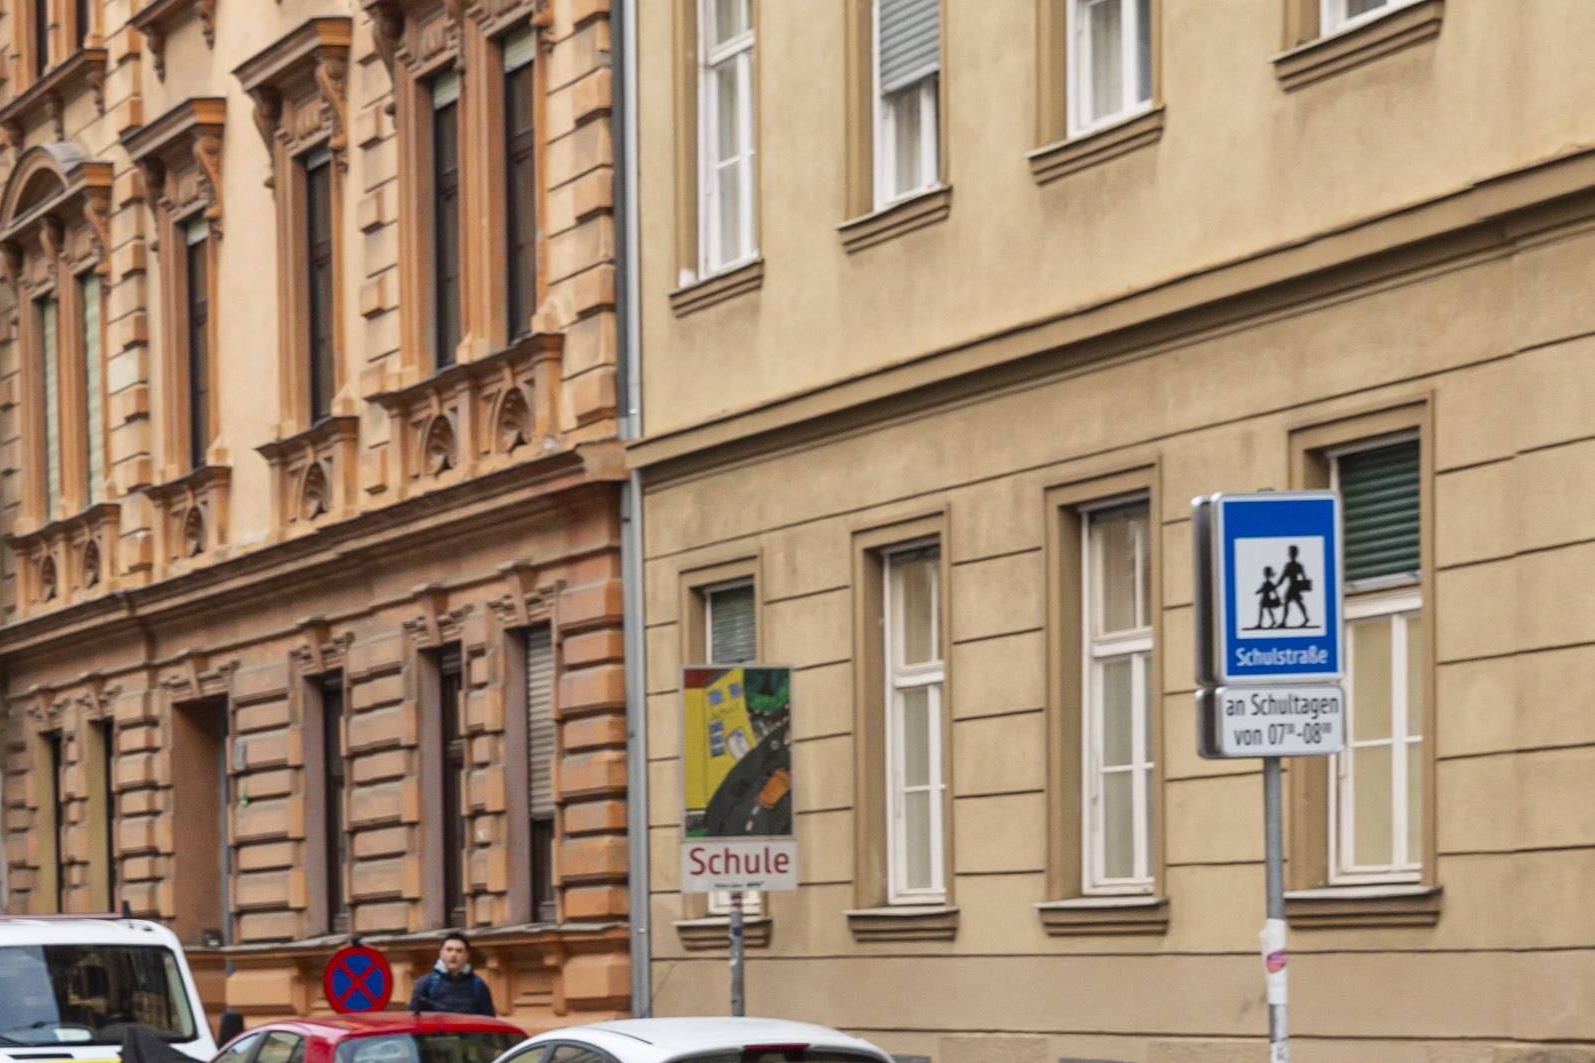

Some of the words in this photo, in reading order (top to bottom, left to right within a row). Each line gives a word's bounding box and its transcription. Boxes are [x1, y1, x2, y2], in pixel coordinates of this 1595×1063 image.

[1234, 645, 1329, 667] Schulstraße
[1225, 699, 1246, 716] an
[1250, 693, 1339, 720] Schultagen
[1233, 728, 1263, 746] von
[688, 847, 790, 877] Schule
